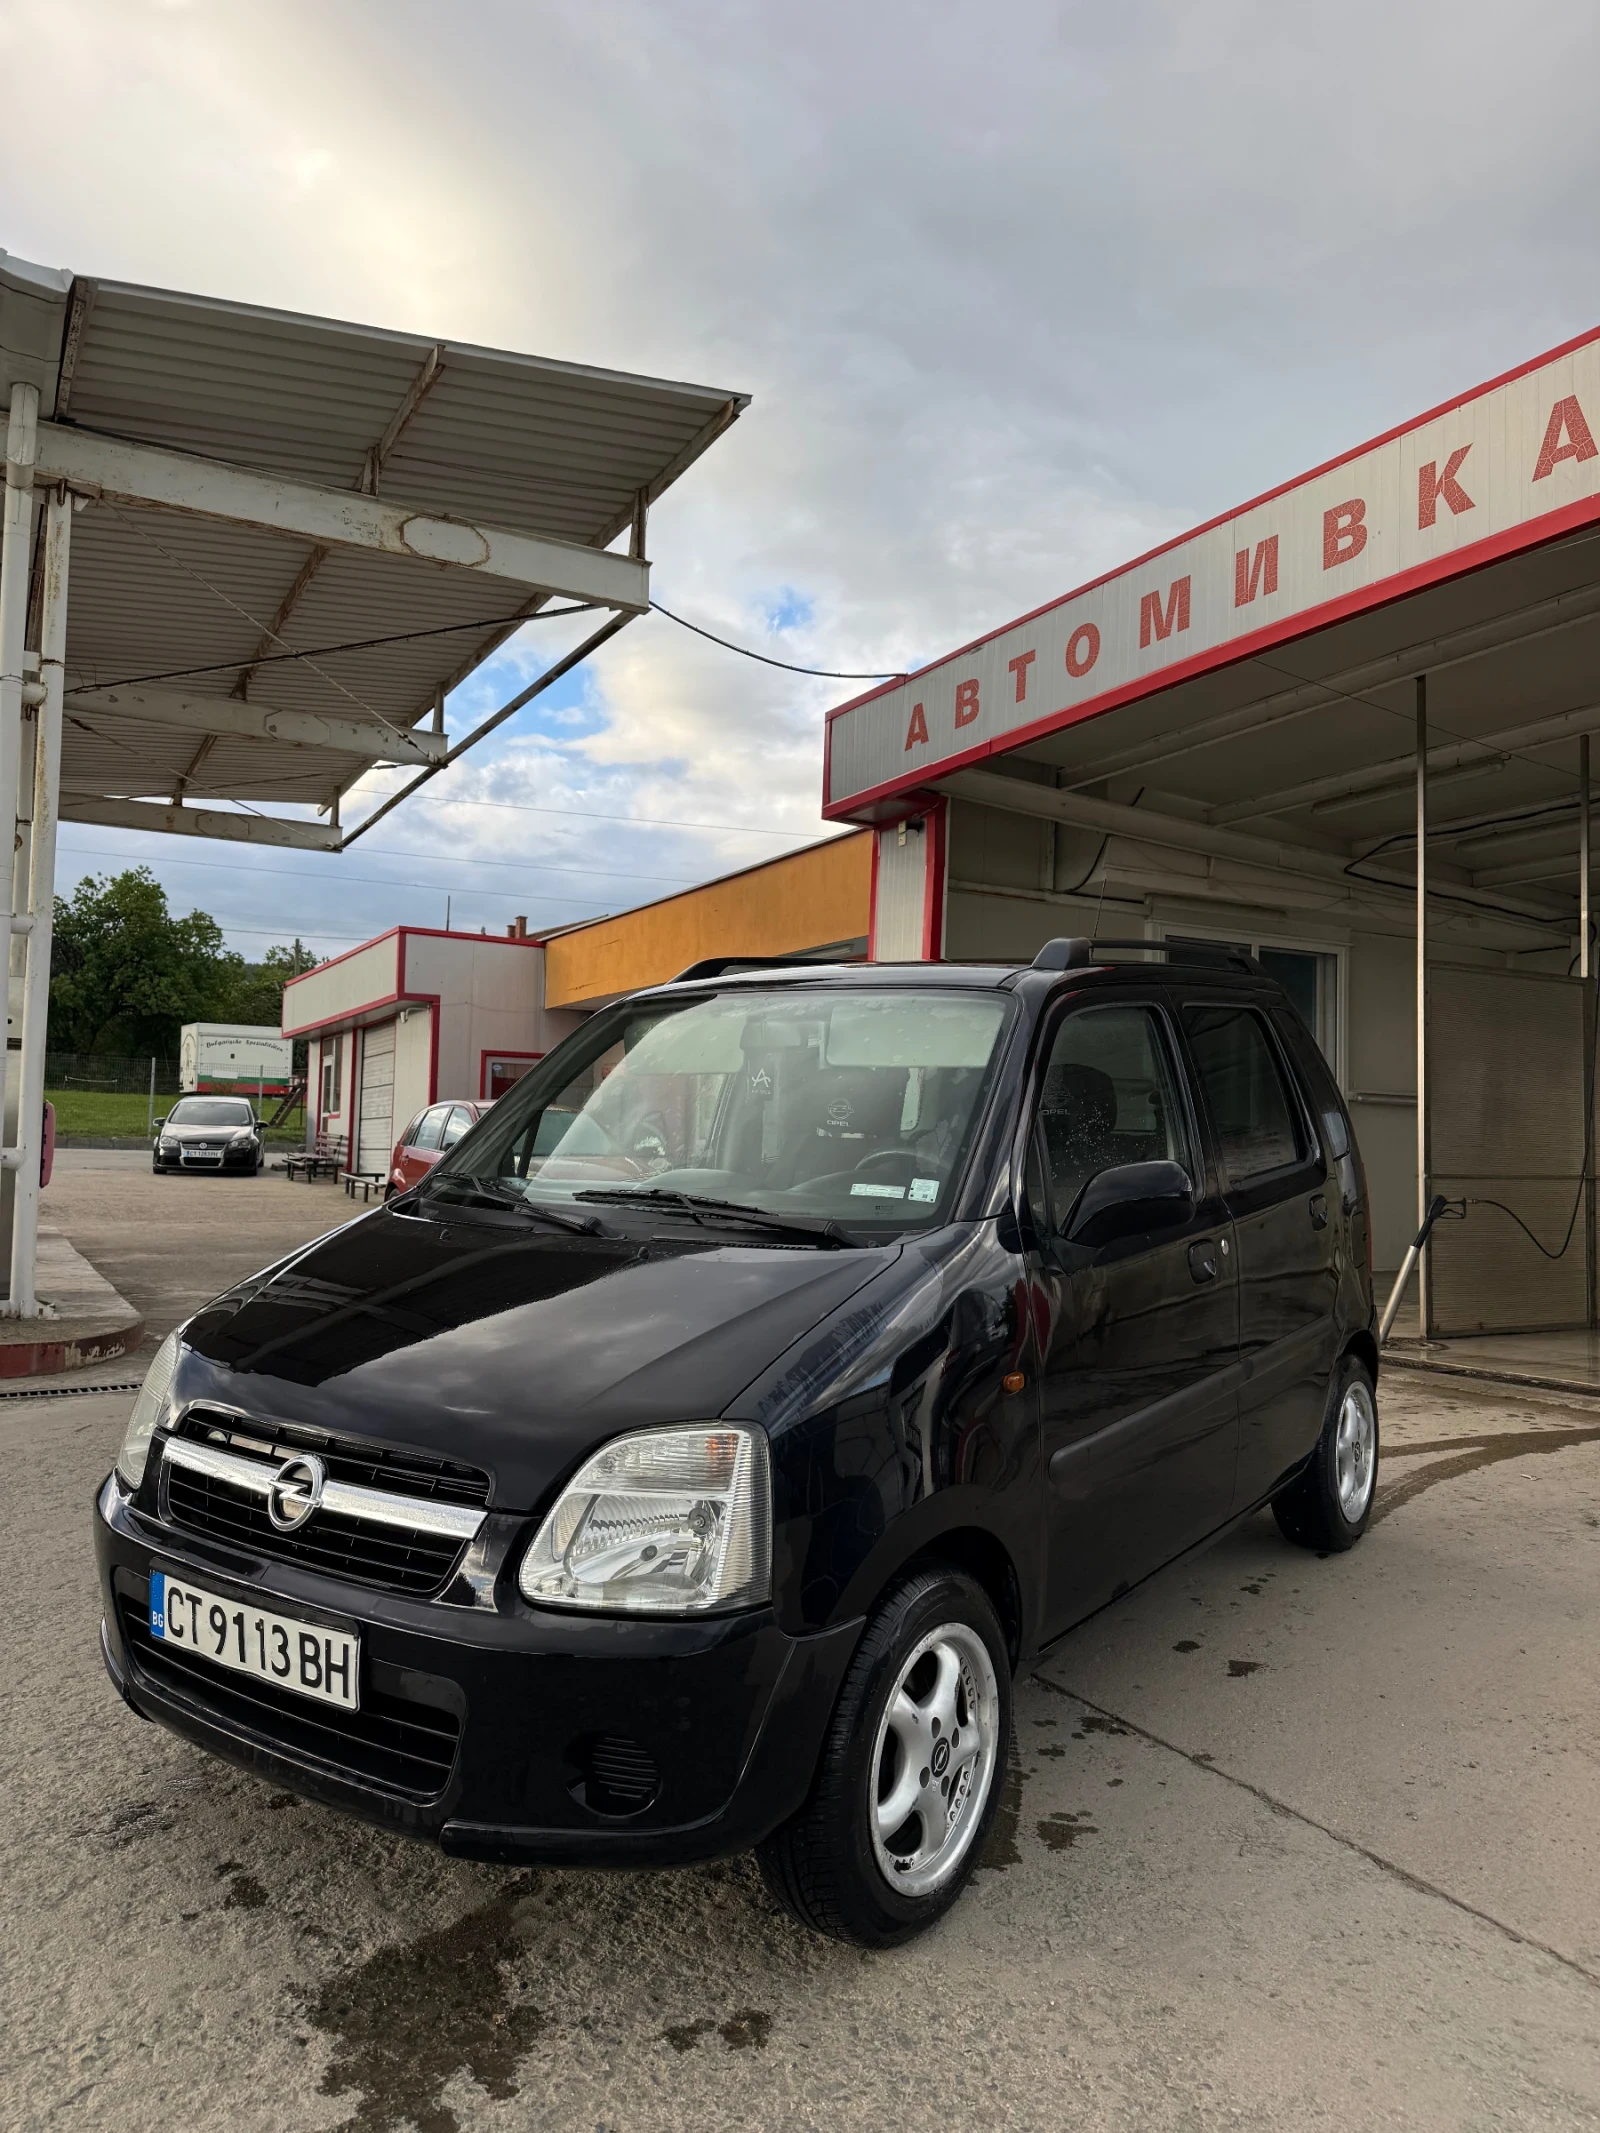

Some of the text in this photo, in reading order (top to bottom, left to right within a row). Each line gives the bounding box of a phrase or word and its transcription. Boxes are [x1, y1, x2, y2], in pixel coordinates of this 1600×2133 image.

[905, 394, 1599, 752] АВТОМИВКА
[206, 1039, 242, 1049] Bulgarische
[245, 1039, 283, 1052] Spezialitäten
[1041, 1108, 1071, 1116] OPEL
[826, 1119, 852, 1127] OPEL
[152, 1610, 164, 1628] BG
